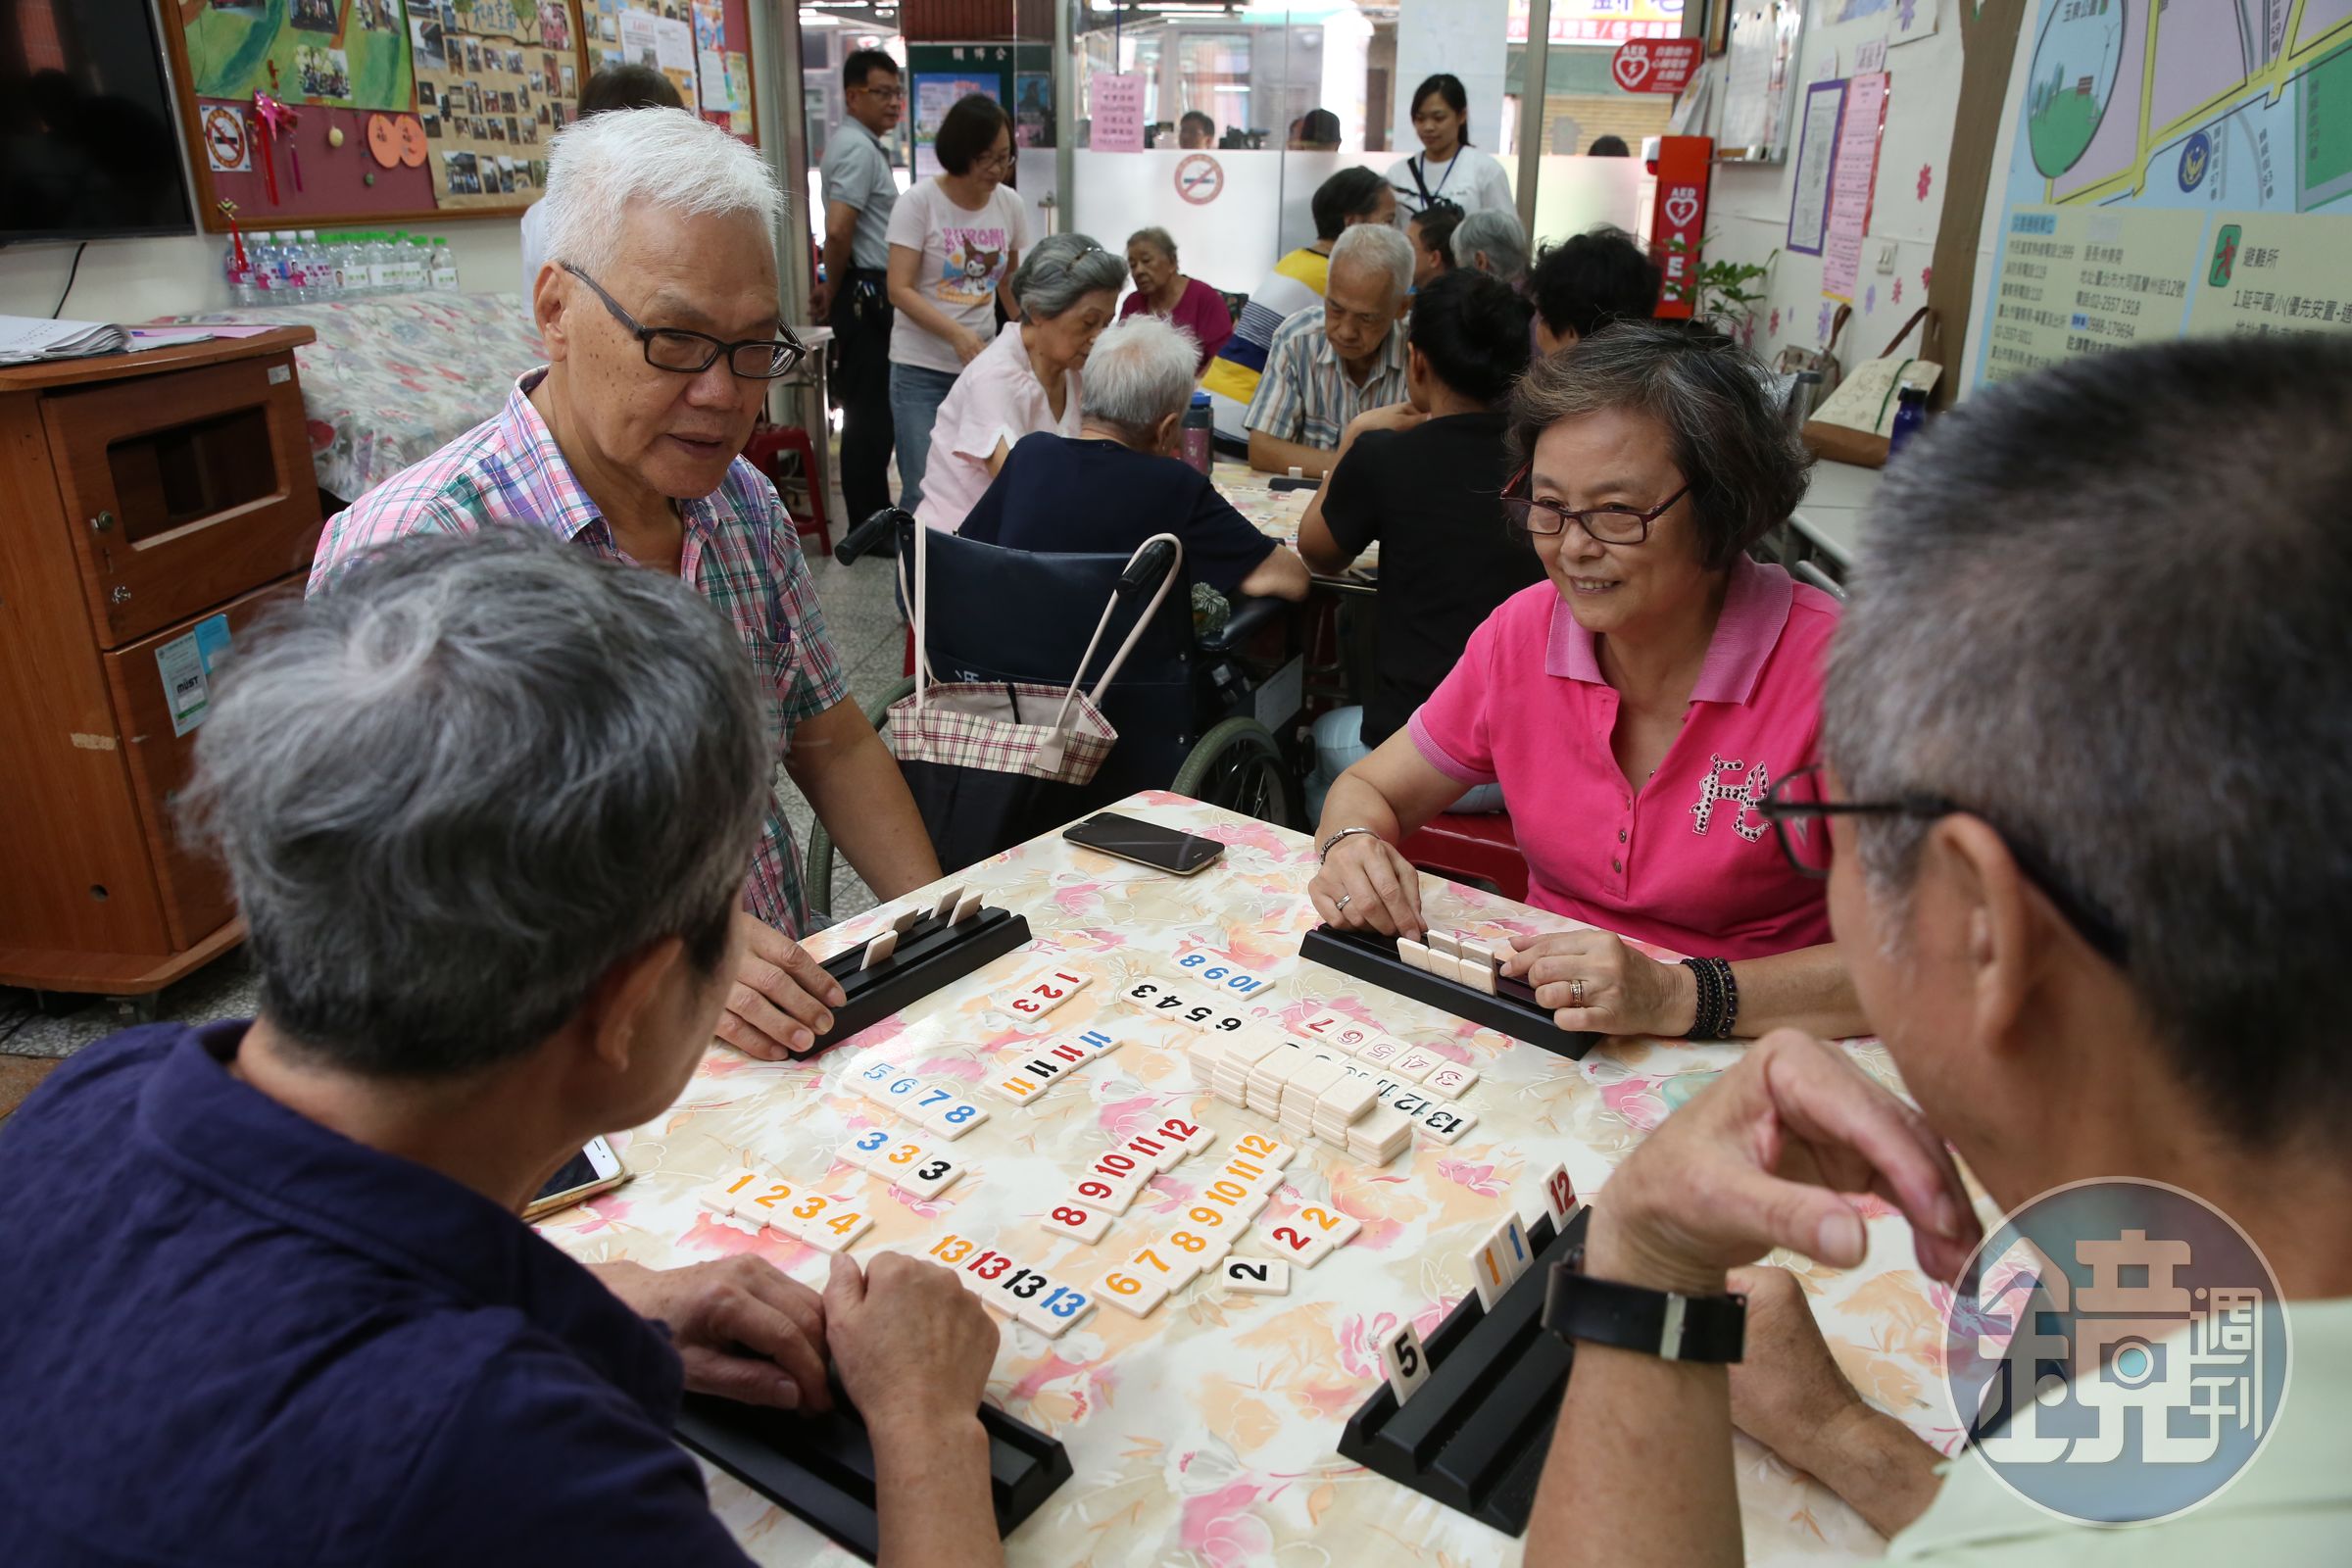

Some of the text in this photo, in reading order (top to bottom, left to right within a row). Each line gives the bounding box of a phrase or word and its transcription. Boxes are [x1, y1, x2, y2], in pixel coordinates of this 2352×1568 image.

[1622, 45, 1647, 57] AED
[1671, 187, 1696, 197] AED
[2243, 247, 2279, 269] 避難所
[1012, 972, 1080, 1012] 1 2 3
[1180, 955, 1206, 967] 8
[1228, 975, 1262, 993] 10
[1131, 984, 1157, 999] 3
[1154, 995, 1183, 1009] 4
[1184, 1006, 1212, 1022] 5
[1002, 1030, 1113, 1096] 11 11 11 11
[1305, 1017, 1335, 1033] 7
[1367, 1043, 1396, 1060] 5
[1400, 1054, 1429, 1071] 4
[1435, 1070, 1463, 1087] 3
[863, 1062, 976, 1123] 5 6 7 8
[1394, 1093, 1434, 1117] 12
[1425, 1111, 1465, 1134] 13
[857, 1132, 951, 1181] 3 3 3
[1052, 1119, 1200, 1226] 8 9 10 11 12
[726, 1174, 861, 1236] 1 2 3 4
[1105, 1135, 1279, 1296] 6 7 8 9 10 11 12
[1549, 1170, 1577, 1216] 12
[1272, 1206, 1341, 1251] 2 2
[929, 1234, 1086, 1317] 13 13 13 13
[1229, 1262, 1267, 1282] 2
[1485, 1223, 1525, 1287] 1 1
[1394, 1332, 1419, 1378] 5
